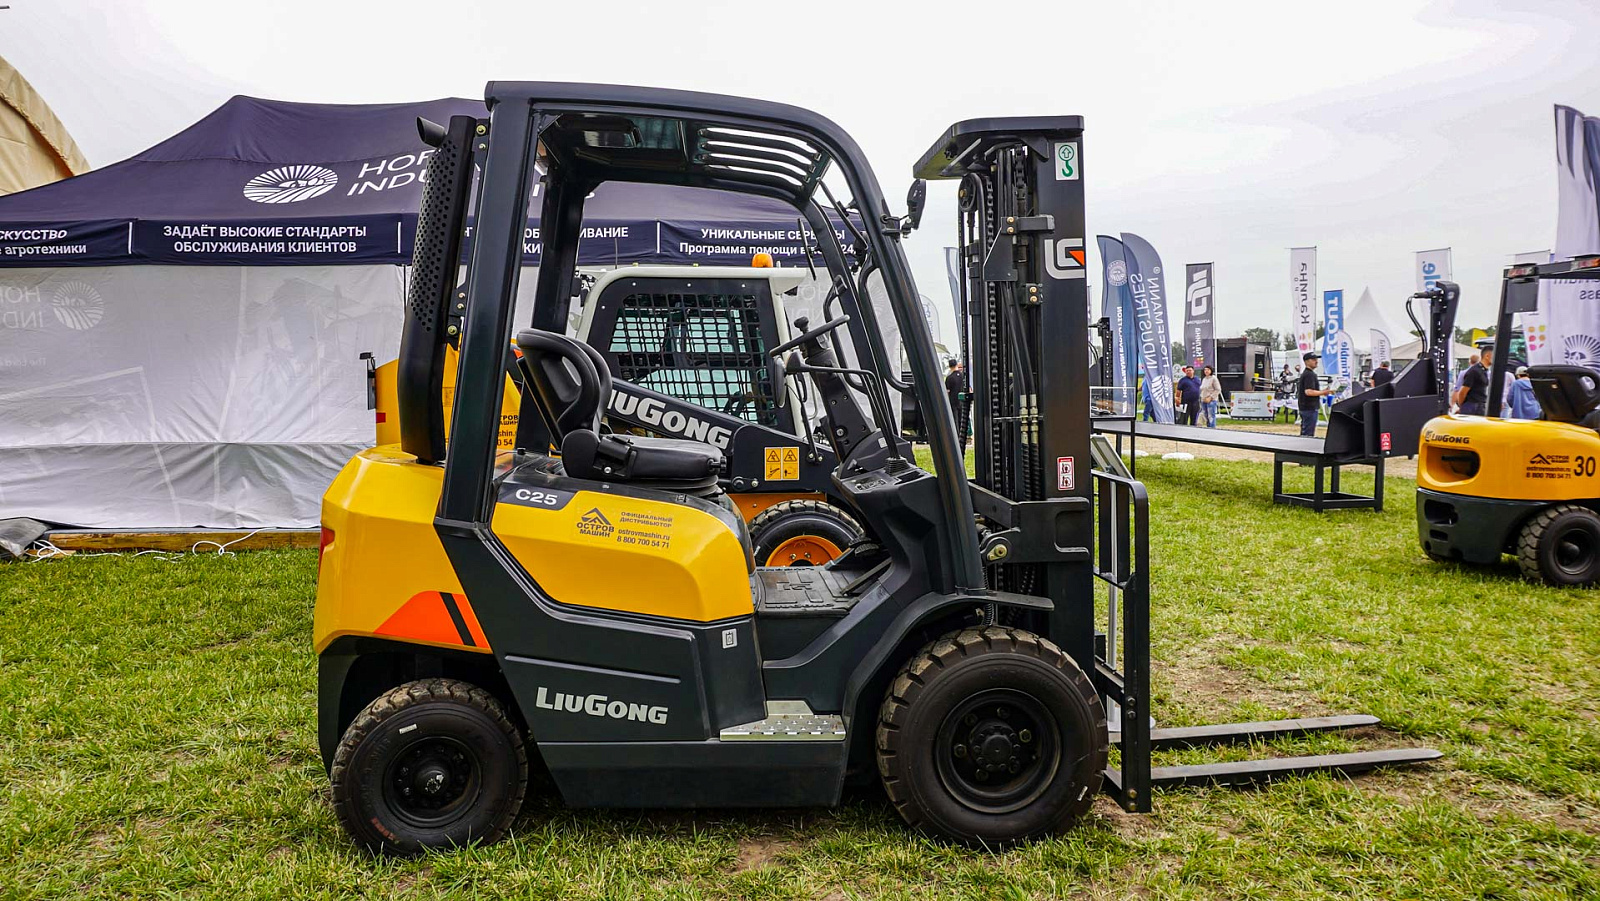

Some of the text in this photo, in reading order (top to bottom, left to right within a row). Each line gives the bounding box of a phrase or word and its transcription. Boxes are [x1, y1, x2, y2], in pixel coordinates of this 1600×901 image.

[163, 224, 367, 238] ЗАДАЁТ ВЫСОКИЕ СТАНДАРТЫ
[701, 228, 785, 240] УНИКАЛЬНЫЕ
[5, 244, 87, 257] агротехники
[174, 241, 357, 253] ОБСЛУЖИВАНИЯ КЛИЕНТОВ
[679, 242, 744, 255] Программа
[749, 245, 797, 256] помощи
[1574, 455, 1596, 477] 30
[515, 489, 558, 506] C25
[619, 517, 672, 528] ДИСТРИБЬЮТОР
[621, 511, 673, 522] ОФИЦИАЛЬНЫЙ
[576, 521, 615, 533] ОСТРОВ
[579, 528, 611, 538] МАШИН
[618, 528, 670, 541] ostrovmashin.ru
[623, 536, 635, 544] 800
[637, 538, 650, 546] 700
[651, 539, 660, 547] 54
[661, 541, 669, 549] 71
